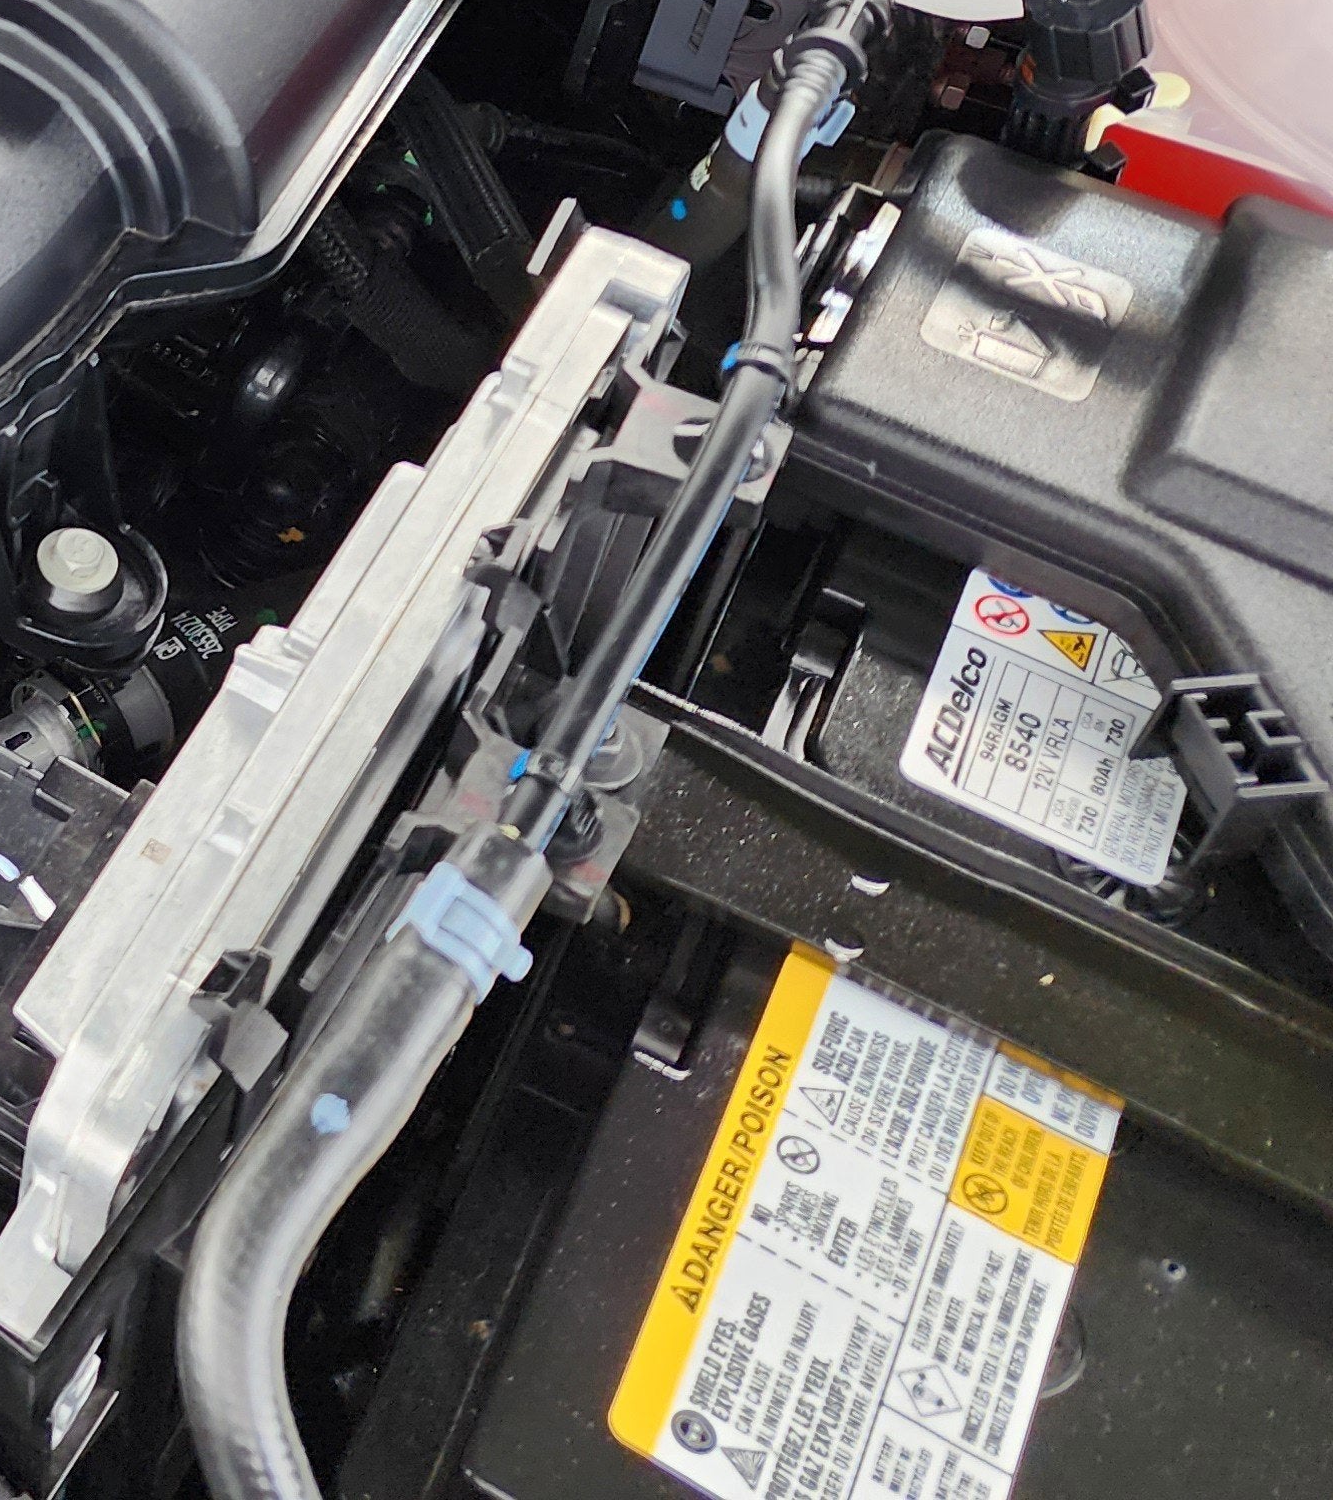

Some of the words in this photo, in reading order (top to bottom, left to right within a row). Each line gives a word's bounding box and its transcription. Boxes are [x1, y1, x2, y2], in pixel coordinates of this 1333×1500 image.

[205, 606, 238, 633] PIPE
[925, 647, 987, 776] ACDelco
[978, 696, 1013, 762] 94RAGM
[1104, 716, 1127, 747] 730
[1002, 709, 1043, 773] 8540
[1041, 713, 1072, 762] VRLA
[1032, 761, 1057, 794] 12V
[1088, 754, 1115, 797] 80Ah
[1076, 804, 1099, 836] 730
[810, 1009, 850, 1076] SULFURIC
[845, 1025, 868, 1054] CAN
[883, 1034, 913, 1084] BURNS.
[832, 1049, 859, 1086] ACID
[839, 1094, 867, 1137] CAUSE
[853, 1029, 891, 1099] BLINDNESS
[896, 1035, 939, 1115] SULFURIQUE
[933, 1071, 953, 1093] LA
[994, 1074, 1019, 1100] DO
[867, 1079, 897, 1129] SEVERE
[916, 1089, 947, 1141] CAUSER
[1049, 1101, 1074, 1127] NE
[860, 1124, 881, 1148] OR
[881, 1109, 913, 1160] L'ACIDE
[905, 1135, 931, 1173] PEUT
[933, 1134, 956, 1164] DES
[680, 1043, 792, 1287] DANGER/POISON
[750, 1202, 773, 1227] NO
[772, 1179, 803, 1229] SPARKS
[791, 1188, 820, 1238] FLAMES
[807, 1189, 839, 1247] SMOKING
[881, 1196, 914, 1259] FLAMMES
[853, 1242, 876, 1272] LES
[873, 1253, 895, 1283] LES
[898, 1227, 926, 1275] FUMER
[892, 1269, 912, 1293] DE
[920, 1285, 944, 1319] EYES
[974, 1274, 997, 1309] HELP
[838, 1314, 872, 1379] PEUVENT
[909, 1312, 935, 1354] FLUSH
[931, 1331, 954, 1365] WITH
[960, 1304, 988, 1356] MEDICAL
[688, 1355, 723, 1411] SHIELD
[708, 1311, 739, 1359] EYES.
[709, 1339, 754, 1423] EXPLOSIVE
[738, 1290, 771, 1344] GASES
[953, 1350, 974, 1378] GET
[744, 1359, 773, 1407] CAUSE
[755, 1370, 795, 1449] BLINDNESS
[781, 1349, 802, 1373] OR
[734, 1403, 757, 1436] CAN
[791, 1396, 816, 1430] LES
[808, 1374, 852, 1460] EXPLOSIFS
[839, 1390, 871, 1449] RENDRE
[798, 1454, 825, 1492] GAZ
